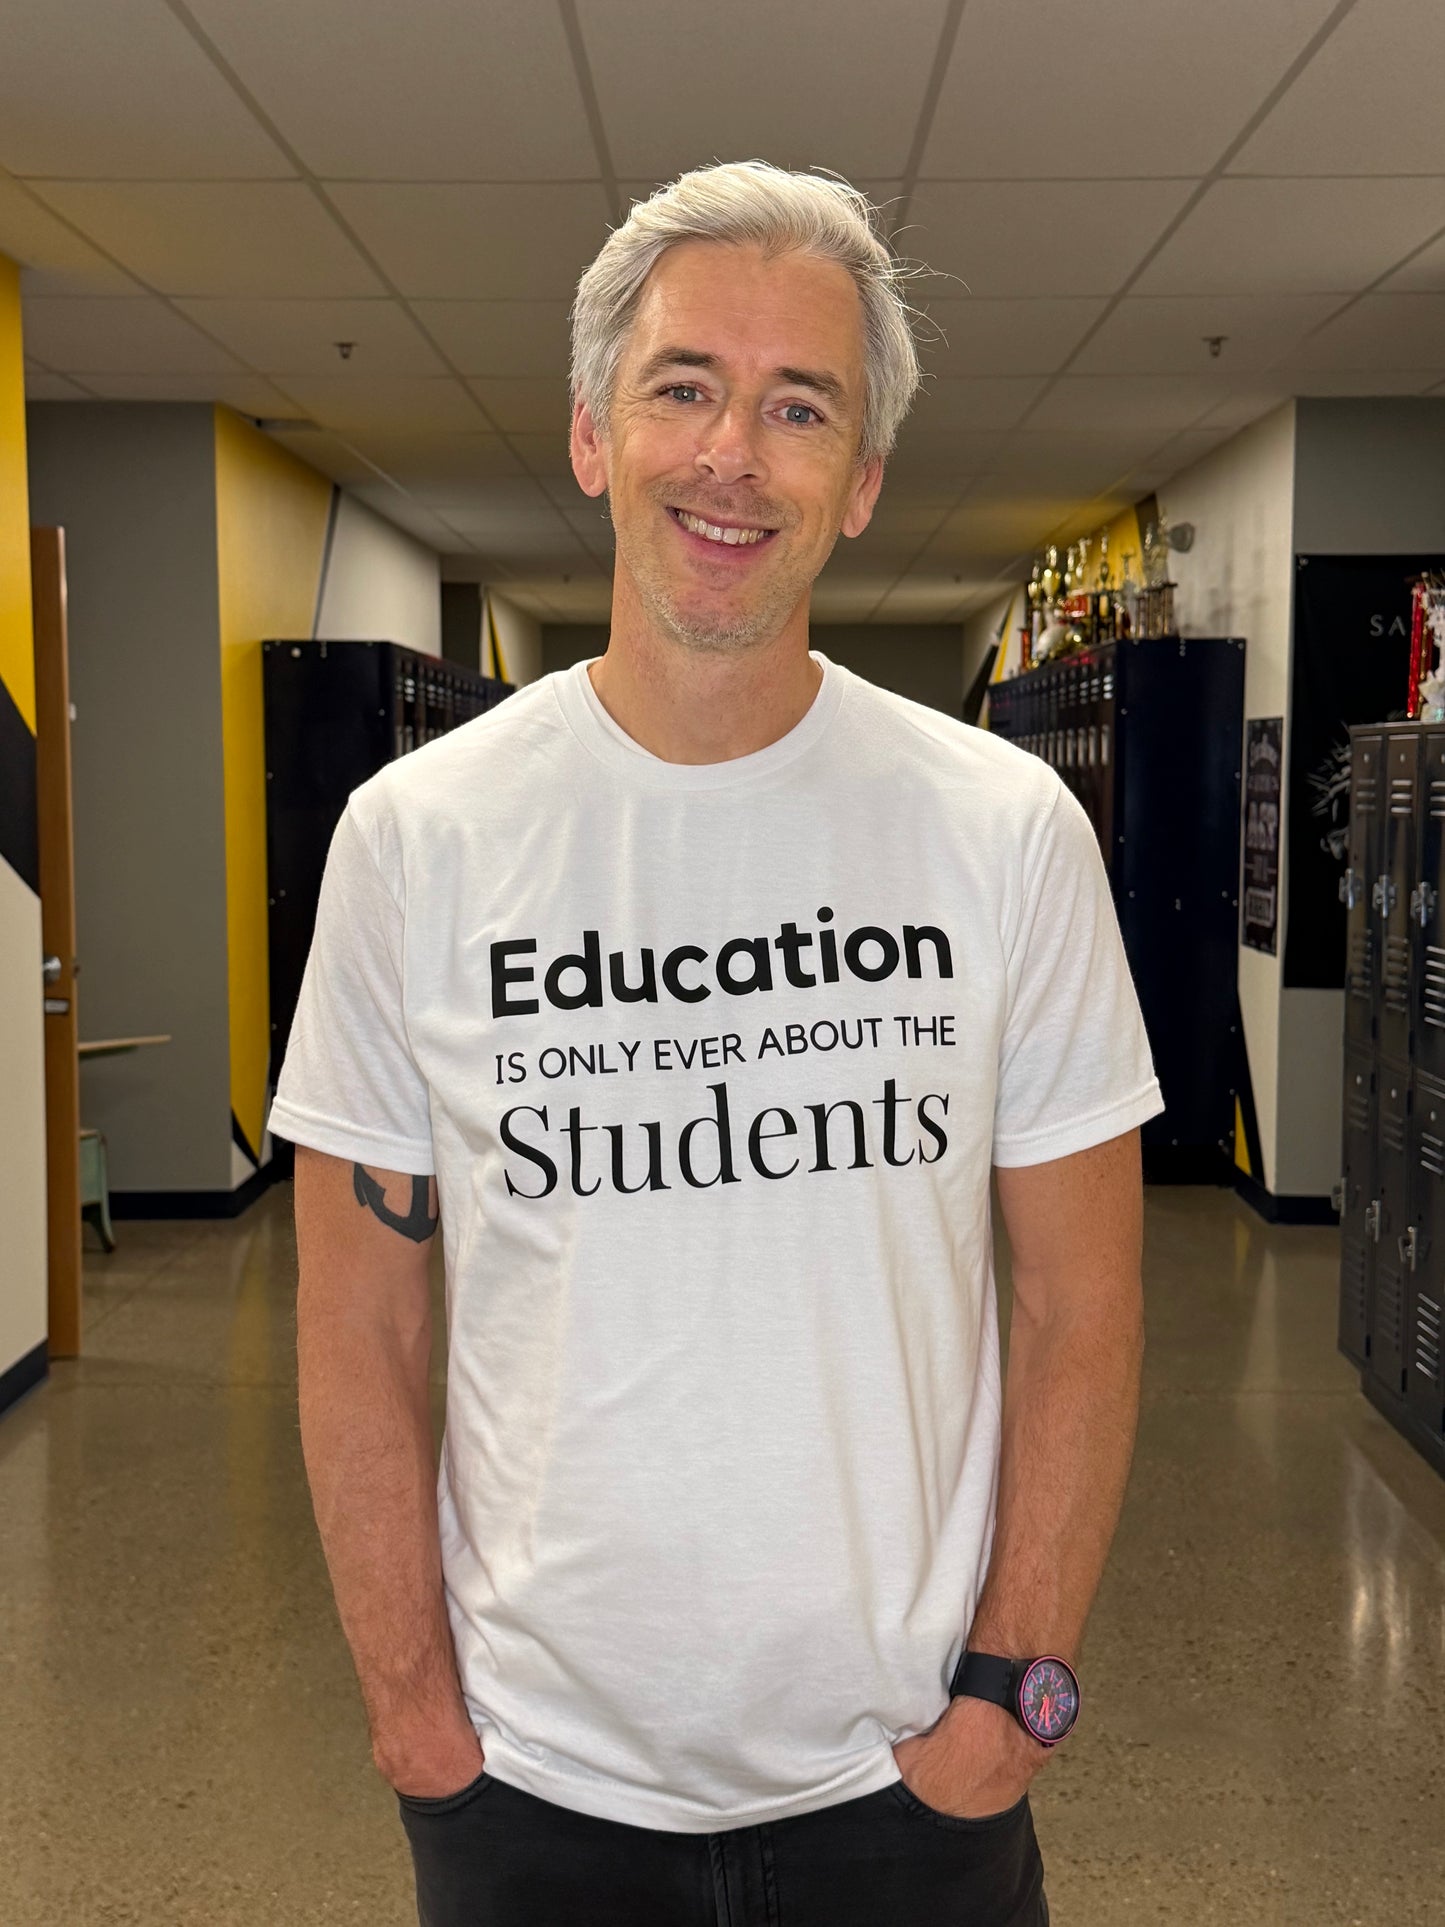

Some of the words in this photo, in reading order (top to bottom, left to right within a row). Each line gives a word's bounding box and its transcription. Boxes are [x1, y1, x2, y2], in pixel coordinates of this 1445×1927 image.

[1369, 614, 1407, 637] SA
[489, 906, 954, 1019] Education
[495, 1052, 527, 1085] IS
[538, 1040, 641, 1079] ONLY
[653, 1033, 747, 1071] EVER
[757, 1017, 883, 1060] ABOUT
[893, 1015, 956, 1047] THE
[499, 1078, 950, 1199] Students
